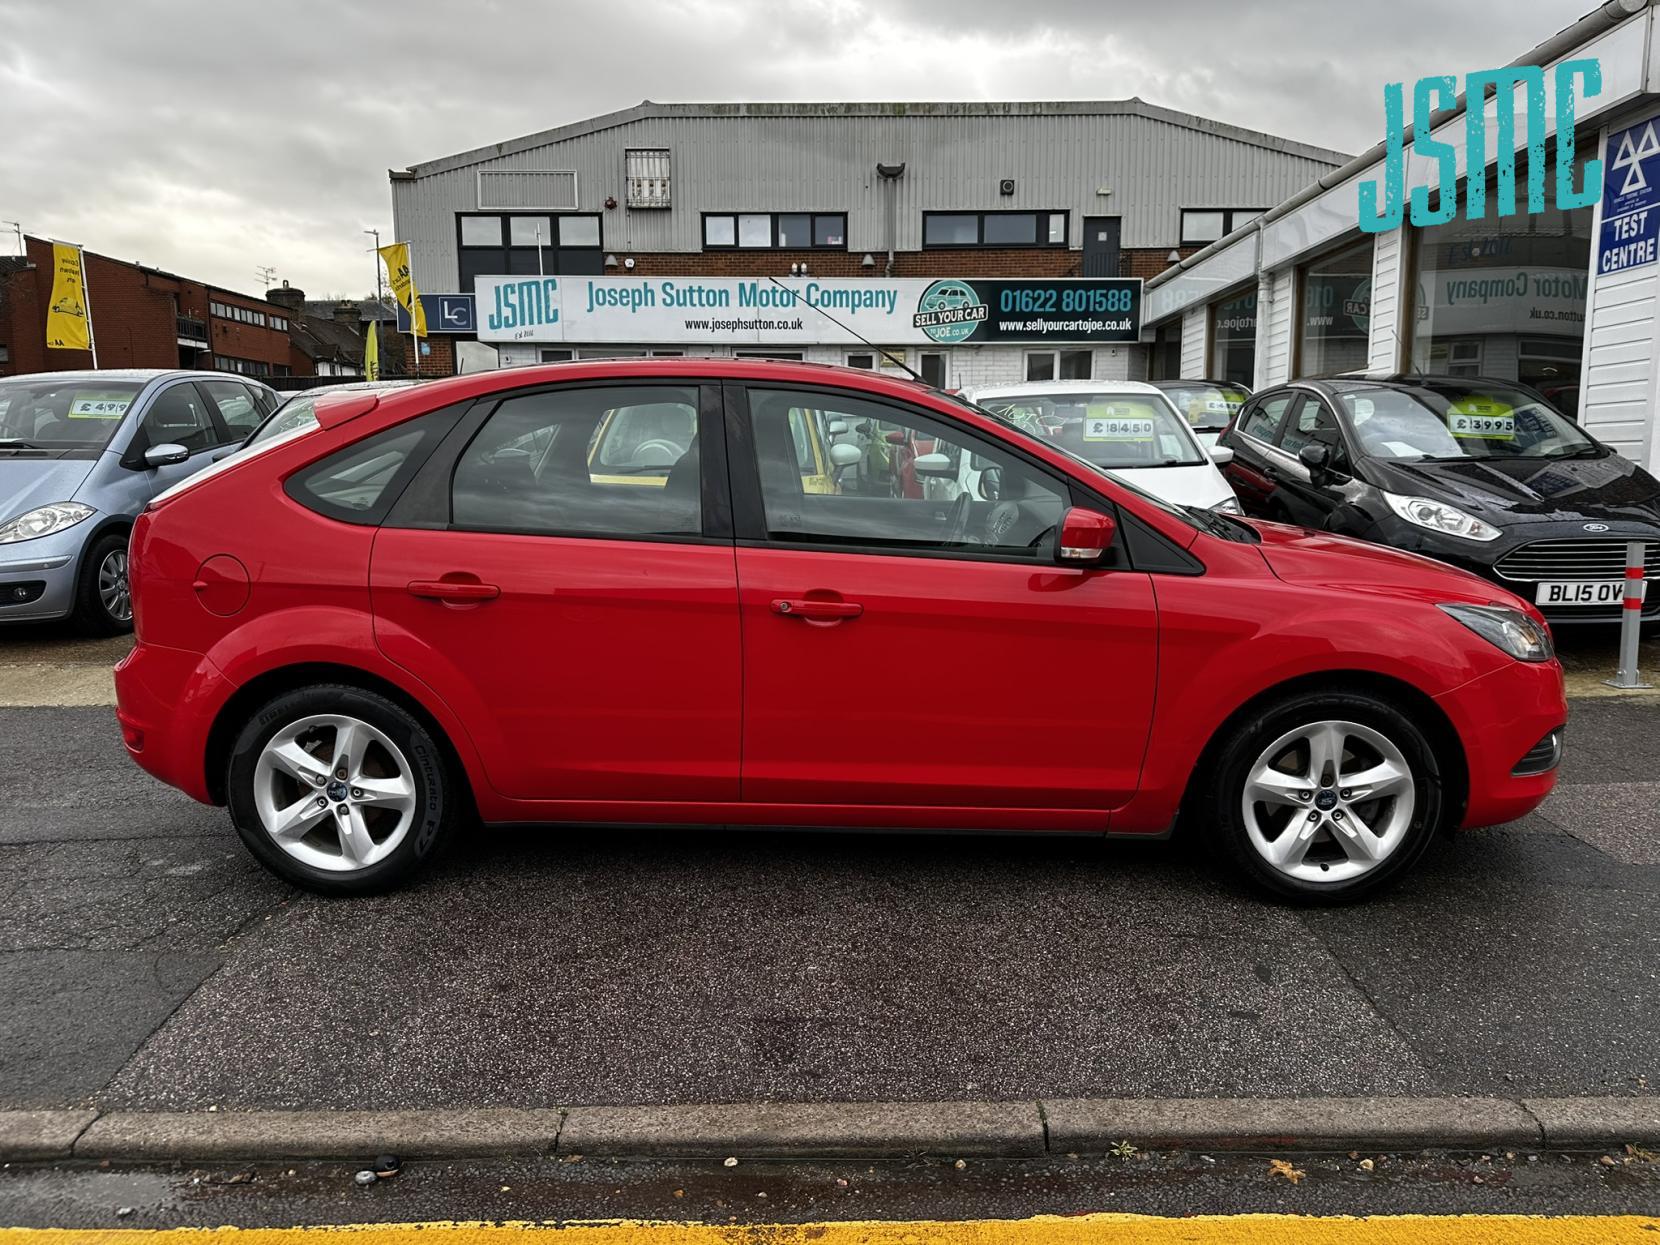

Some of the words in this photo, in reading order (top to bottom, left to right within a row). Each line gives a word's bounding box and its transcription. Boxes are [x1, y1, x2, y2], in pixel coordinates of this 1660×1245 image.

[1613, 211, 1648, 241] TEST
[1602, 238, 1655, 272] CENTRE
[488, 278, 559, 330] JSMC
[586, 281, 655, 313] Joseph
[661, 281, 729, 307] Sutton
[738, 282, 800, 307] Motor
[806, 282, 898, 314] Company
[1000, 289, 1057, 312] 01622
[1062, 289, 1132, 312] 801588
[685, 317, 803, 332] www.josephsutton.co.uk
[915, 313, 937, 326] SELL
[938, 309, 964, 323] YOUR
[964, 307, 985, 320] CAR
[999, 317, 1132, 334] www.sellyourcartojoe.co.uk
[80, 403, 127, 412] £499
[1093, 422, 1152, 433] £8450
[1456, 419, 1513, 431] £3995
[1548, 584, 1594, 602] BL15
[1597, 584, 1623, 602] OV
